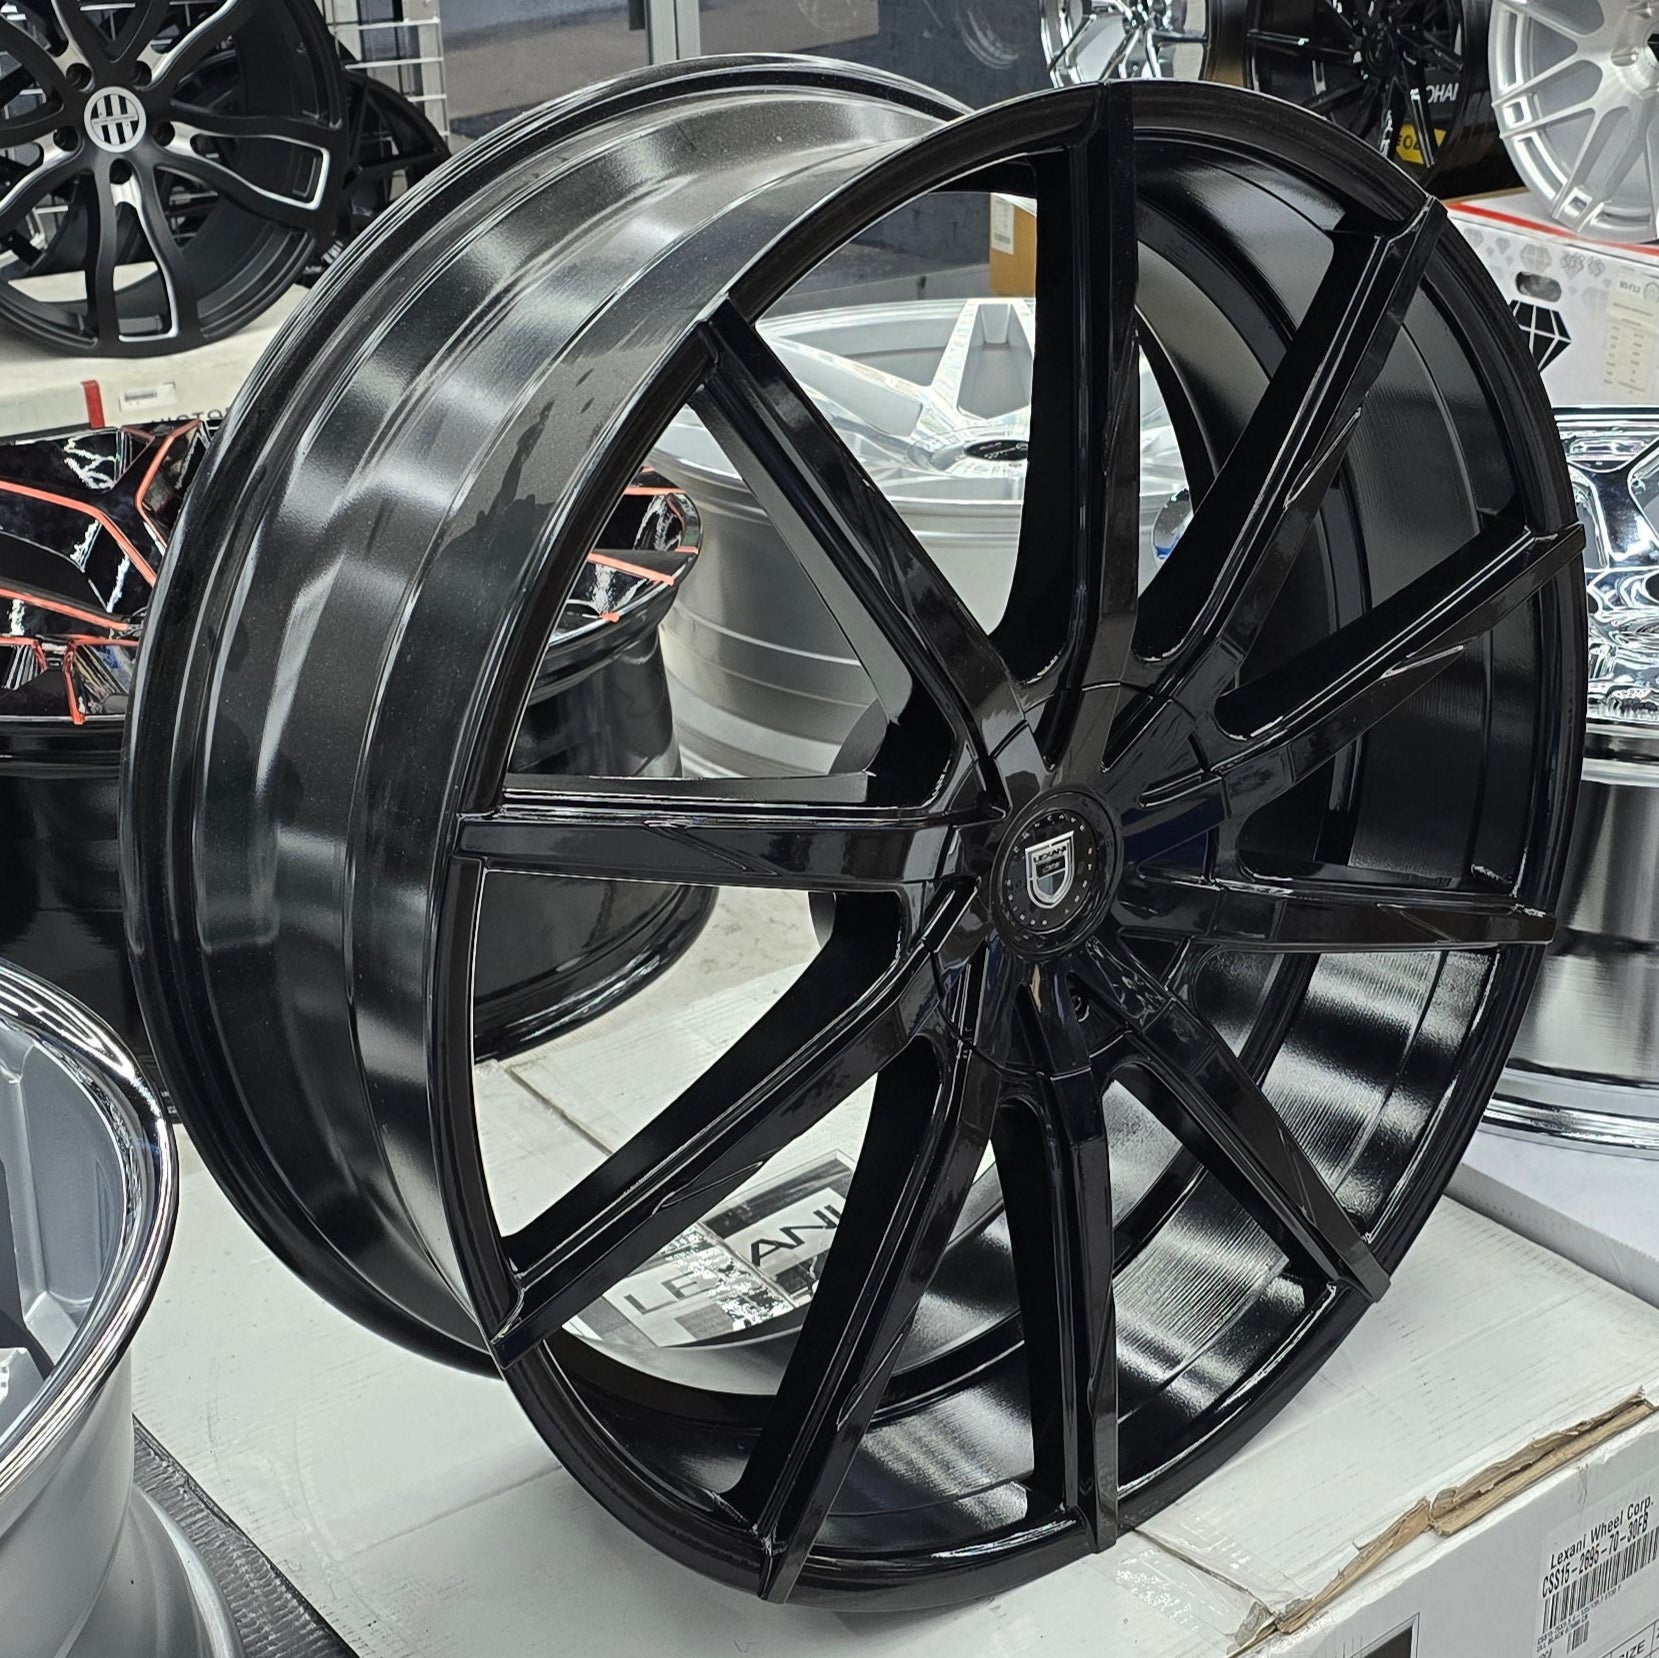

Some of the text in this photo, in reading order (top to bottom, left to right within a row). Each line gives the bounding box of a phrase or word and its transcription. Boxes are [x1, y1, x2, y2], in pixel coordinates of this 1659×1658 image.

[1033, 845, 1067, 863] LEXANI
[623, 1204, 842, 1316] LEANI
[1550, 1495, 1654, 1570] Lexani Wheel Corp.
